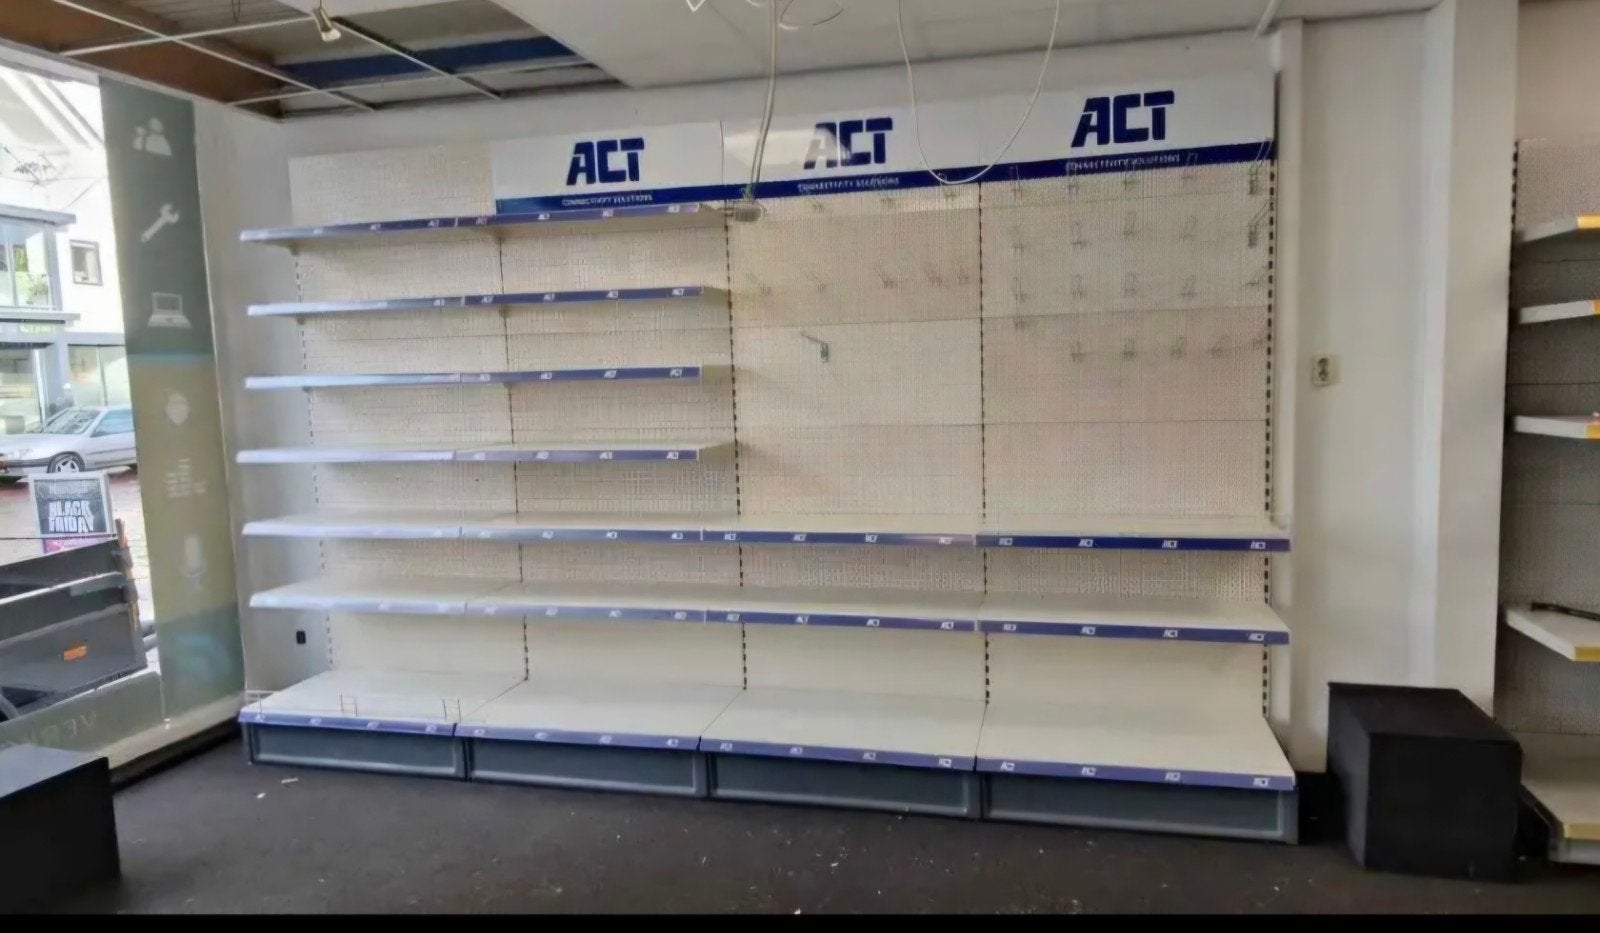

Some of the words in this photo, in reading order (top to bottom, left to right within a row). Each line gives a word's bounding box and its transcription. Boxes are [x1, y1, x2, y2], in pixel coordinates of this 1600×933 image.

[804, 118, 893, 169] ACT
[1071, 90, 1175, 148] ACT
[566, 138, 644, 185] ACT
